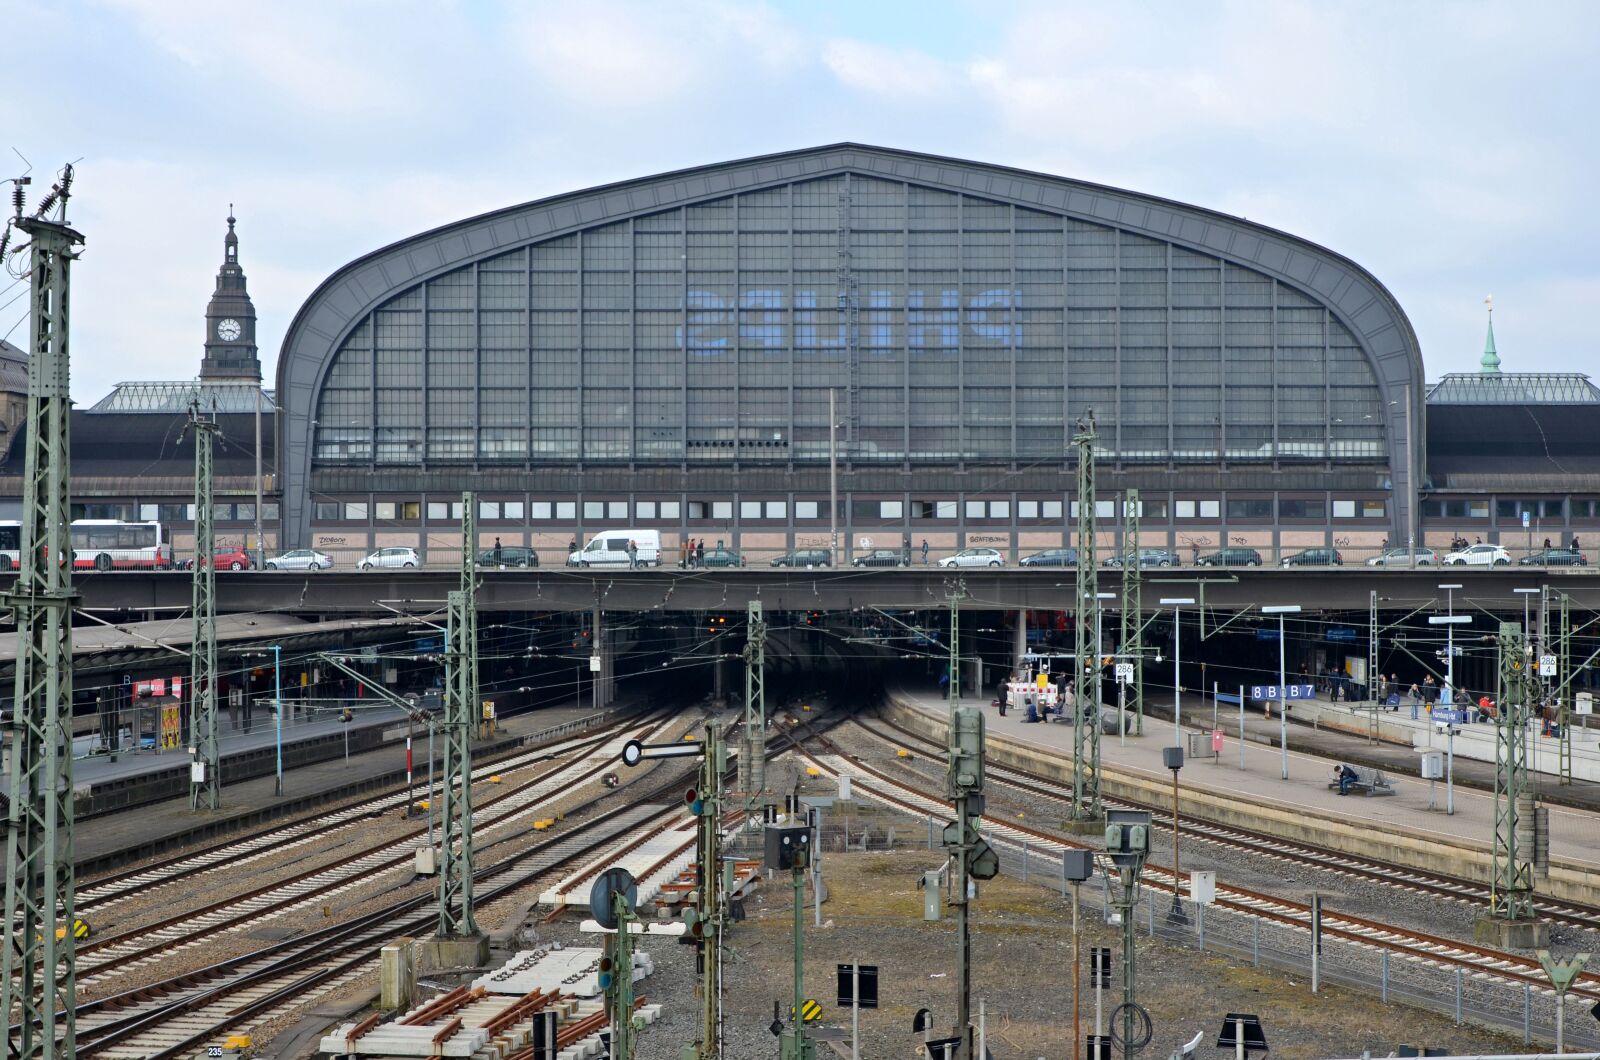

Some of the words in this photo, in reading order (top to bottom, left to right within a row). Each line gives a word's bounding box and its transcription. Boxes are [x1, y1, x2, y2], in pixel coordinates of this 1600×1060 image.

[1541, 657, 1556, 665] 286
[1117, 665, 1132, 673] 286
[1546, 665, 1551, 673] 4
[124, 675, 131, 685] B
[1254, 686, 1262, 698] 8
[1268, 686, 1277, 697] B
[1291, 686, 1299, 697] B
[1306, 685, 1313, 696] 7
[208, 1047, 222, 1056] 235
